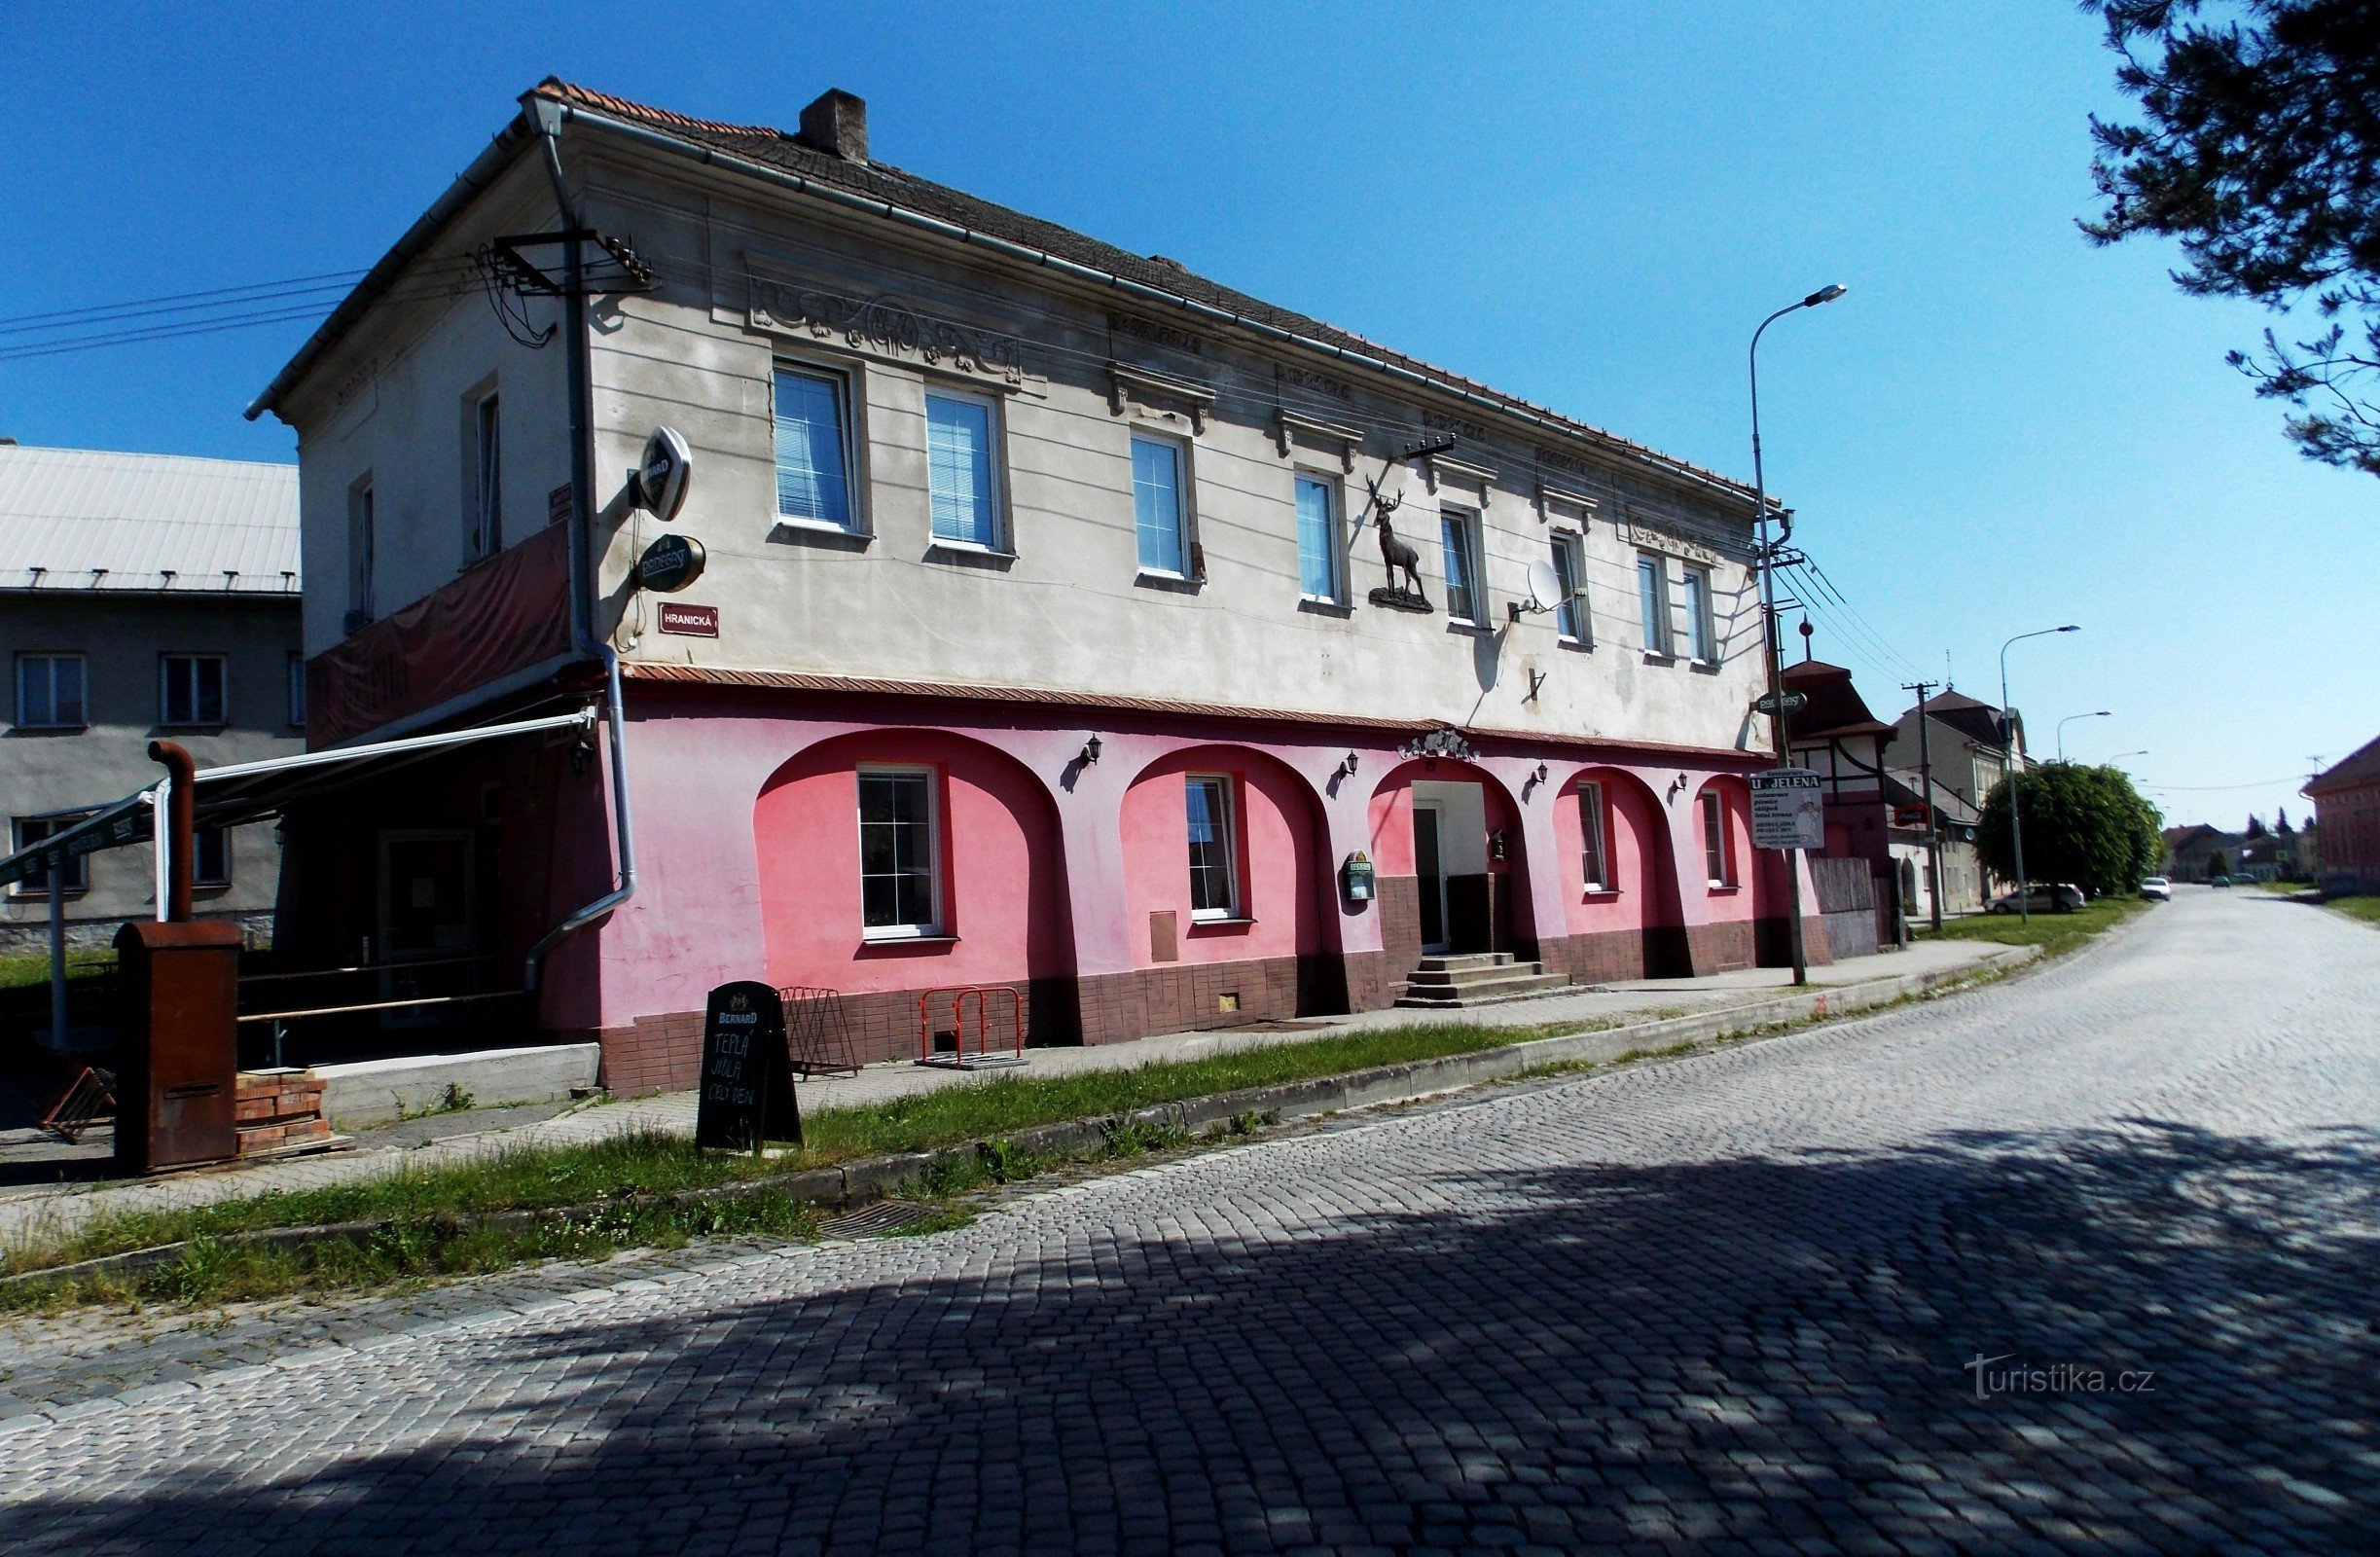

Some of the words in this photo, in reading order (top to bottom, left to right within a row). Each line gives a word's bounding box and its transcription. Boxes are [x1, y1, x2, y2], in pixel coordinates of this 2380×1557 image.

[642, 548, 686, 578] RADEGAST
[665, 613, 712, 627] HRANICKÁ
[1759, 696, 1799, 709] RADGAST
[1751, 778, 1761, 789] U
[1771, 777, 1819, 788] JELENA
[718, 1012, 757, 1024] BERNARD
[713, 1029, 754, 1058] TEPLÁ
[732, 1086, 755, 1105] DEN
